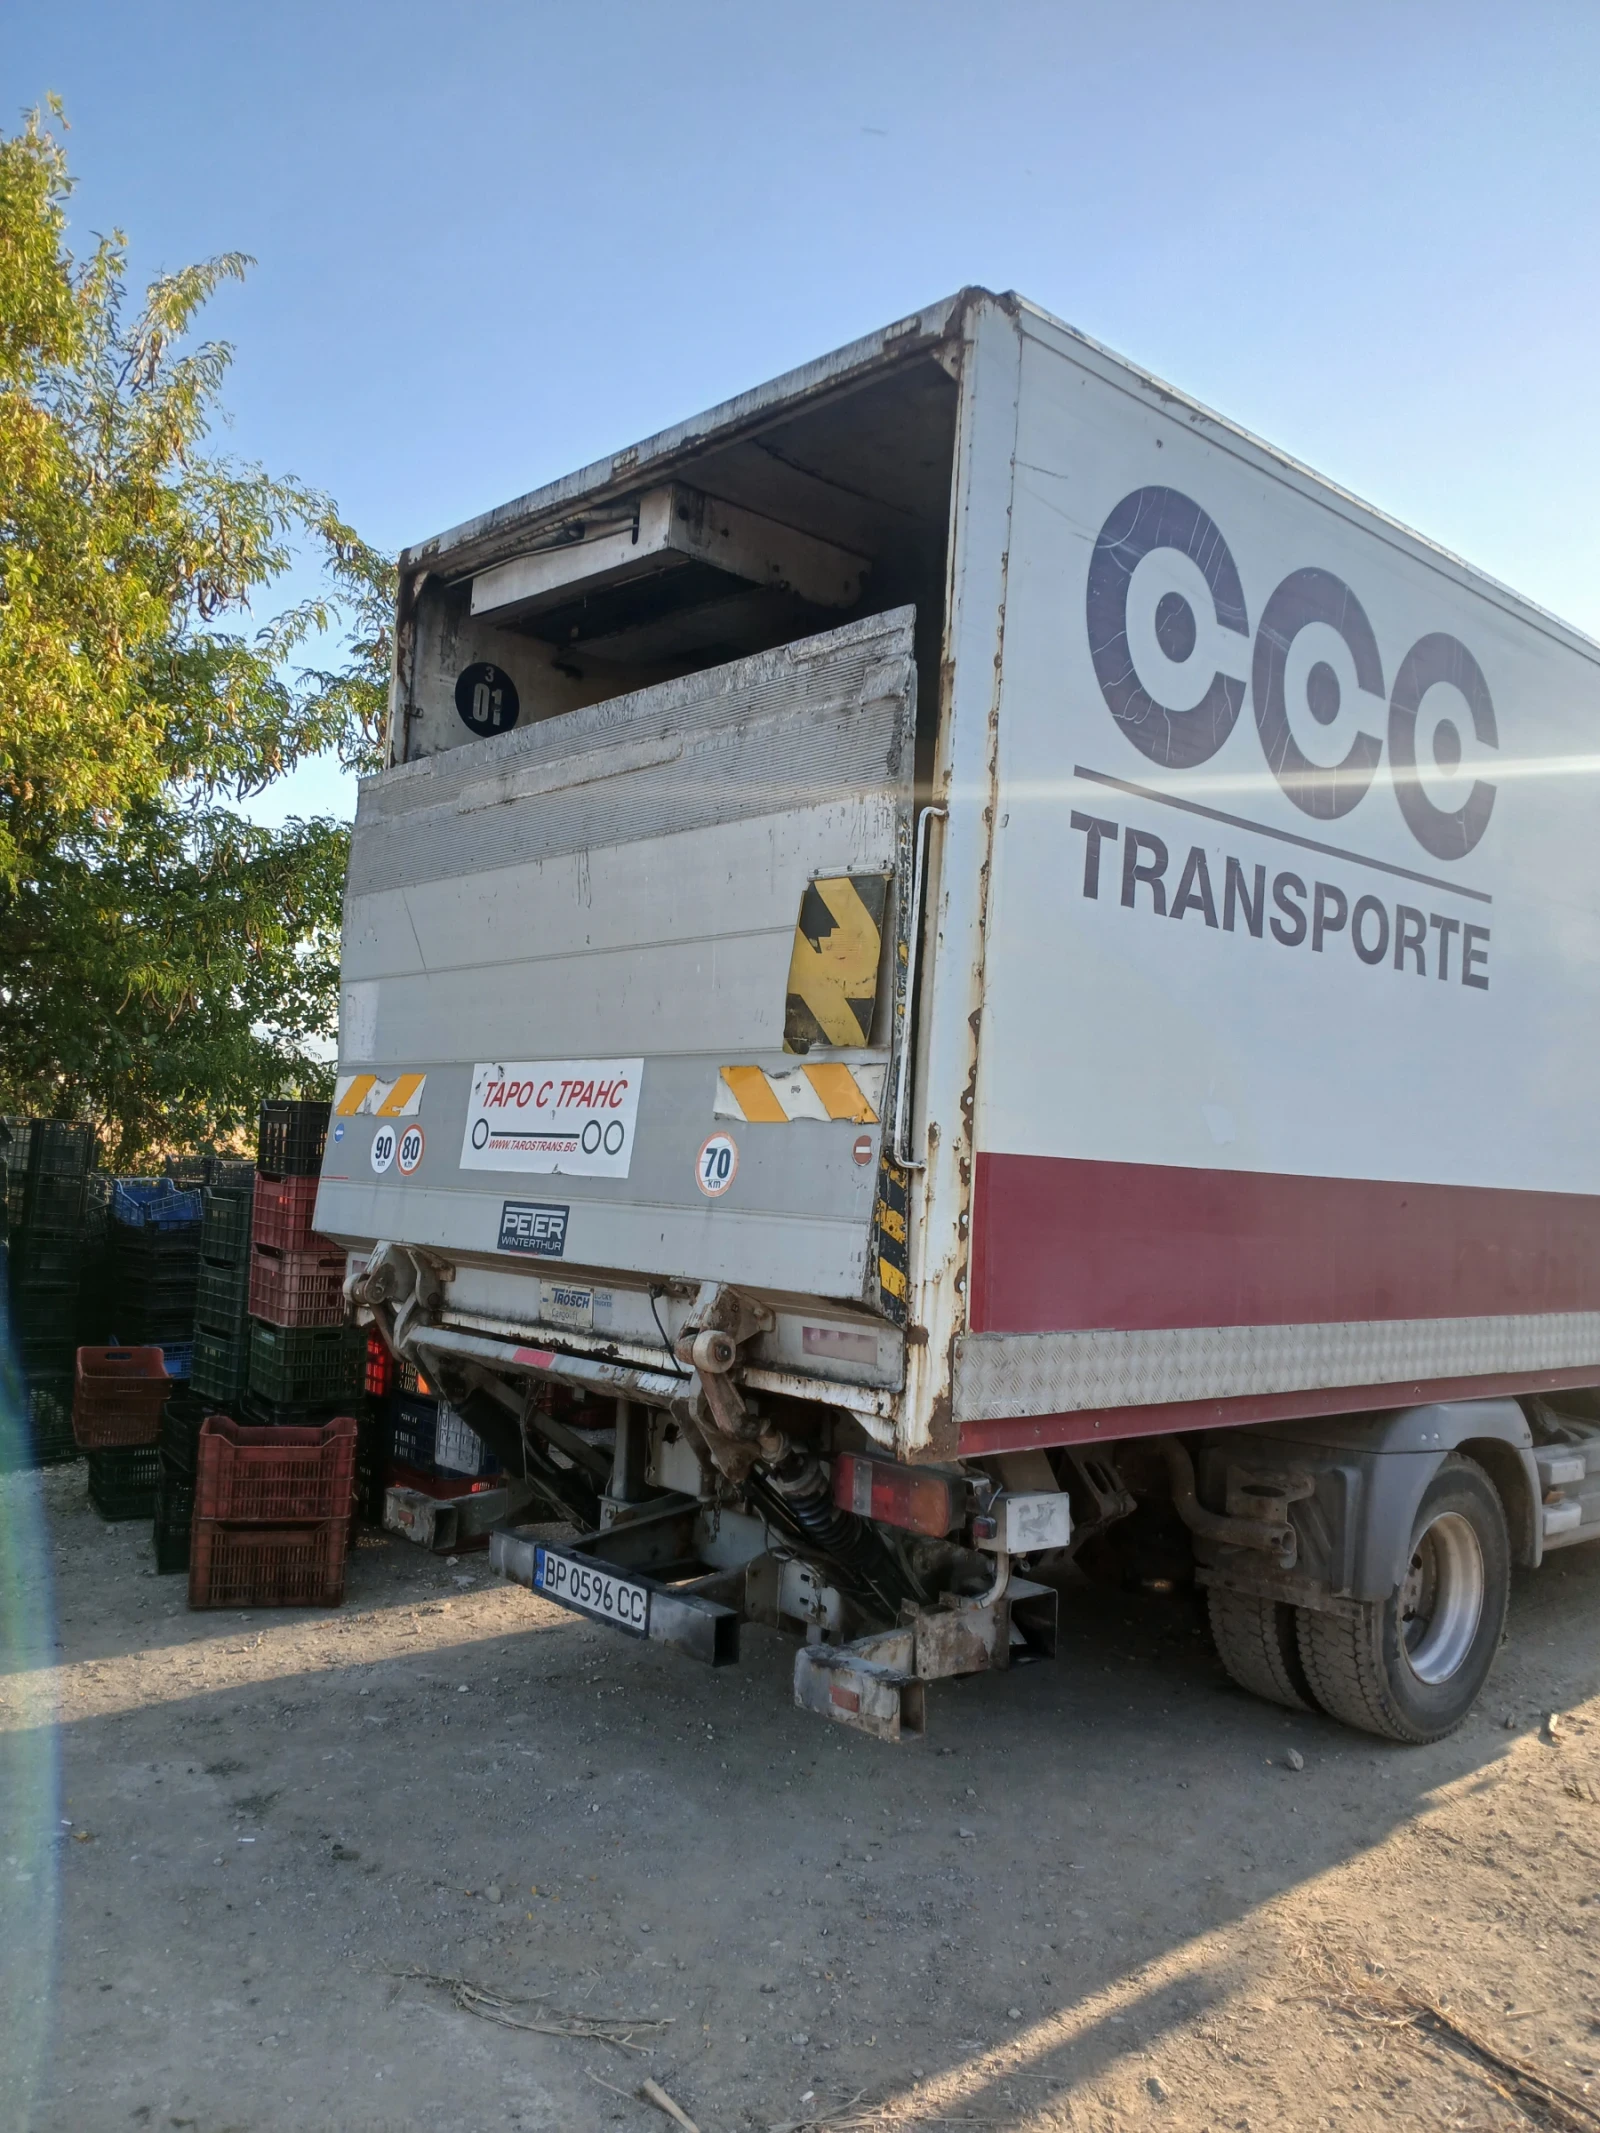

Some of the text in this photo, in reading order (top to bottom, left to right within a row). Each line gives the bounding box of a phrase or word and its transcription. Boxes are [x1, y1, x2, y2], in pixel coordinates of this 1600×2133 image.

[485, 666, 495, 682] 3
[1086, 485, 1499, 861] CCC
[473, 683, 502, 726] 01
[1070, 809, 1492, 991] TRANSPORTE
[483, 1079, 629, 1109] ТАРО С ТРАНС
[375, 1136, 393, 1160] 90
[402, 1136, 420, 1160] 80
[488, 1139, 578, 1153] WWW.TAROSTRANS.BG
[705, 1148, 731, 1179] 70
[502, 1206, 566, 1240] PETER
[501, 1235, 562, 1251] WINTERTHUR
[551, 1287, 591, 1309] TRÖSCH
[545, 1556, 643, 1623] BP 0596 CC
